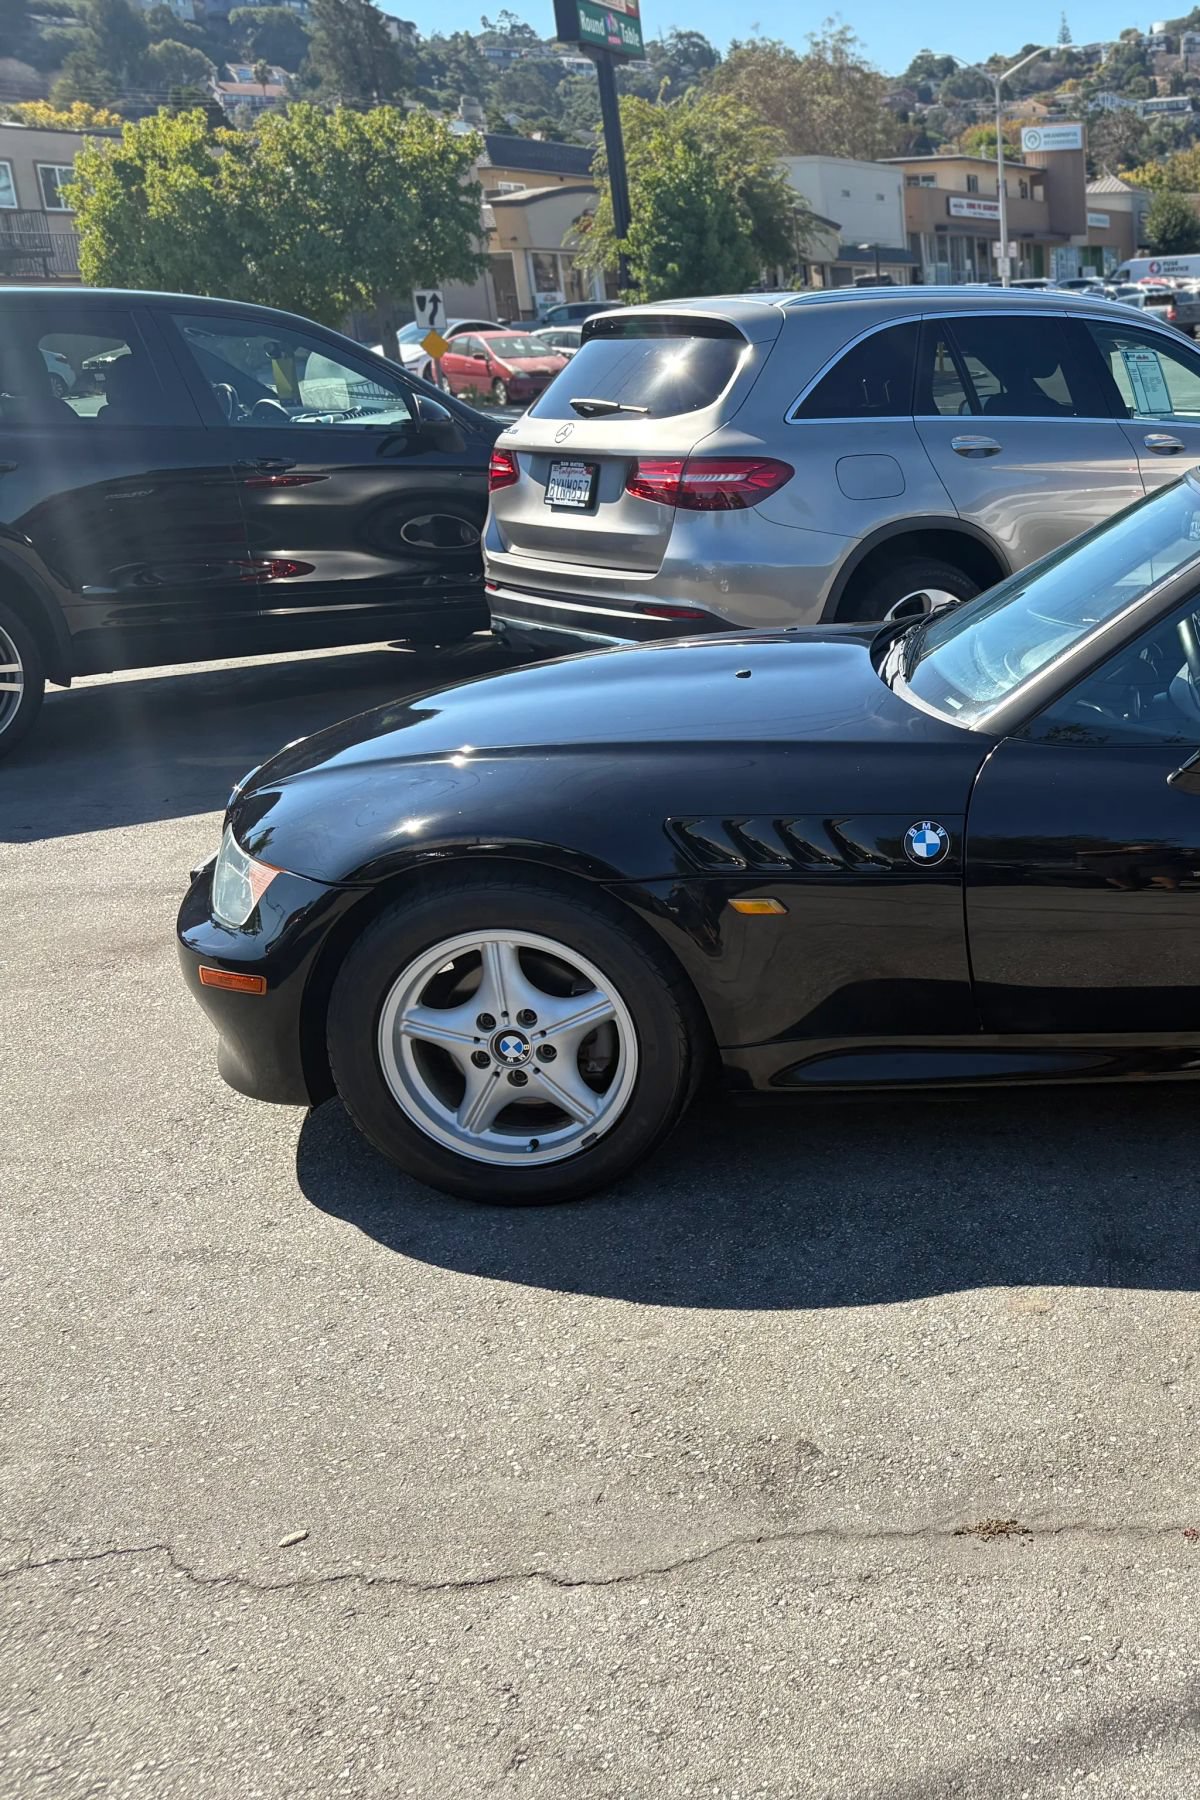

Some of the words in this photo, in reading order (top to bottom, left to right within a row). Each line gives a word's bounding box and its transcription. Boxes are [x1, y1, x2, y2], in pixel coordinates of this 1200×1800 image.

[579, 9, 606, 36] Round
[619, 22, 641, 47] Table
[1163, 265, 1190, 273] SERVICE
[908, 822, 946, 838] BMW
[506, 1044, 530, 1063] BMW
